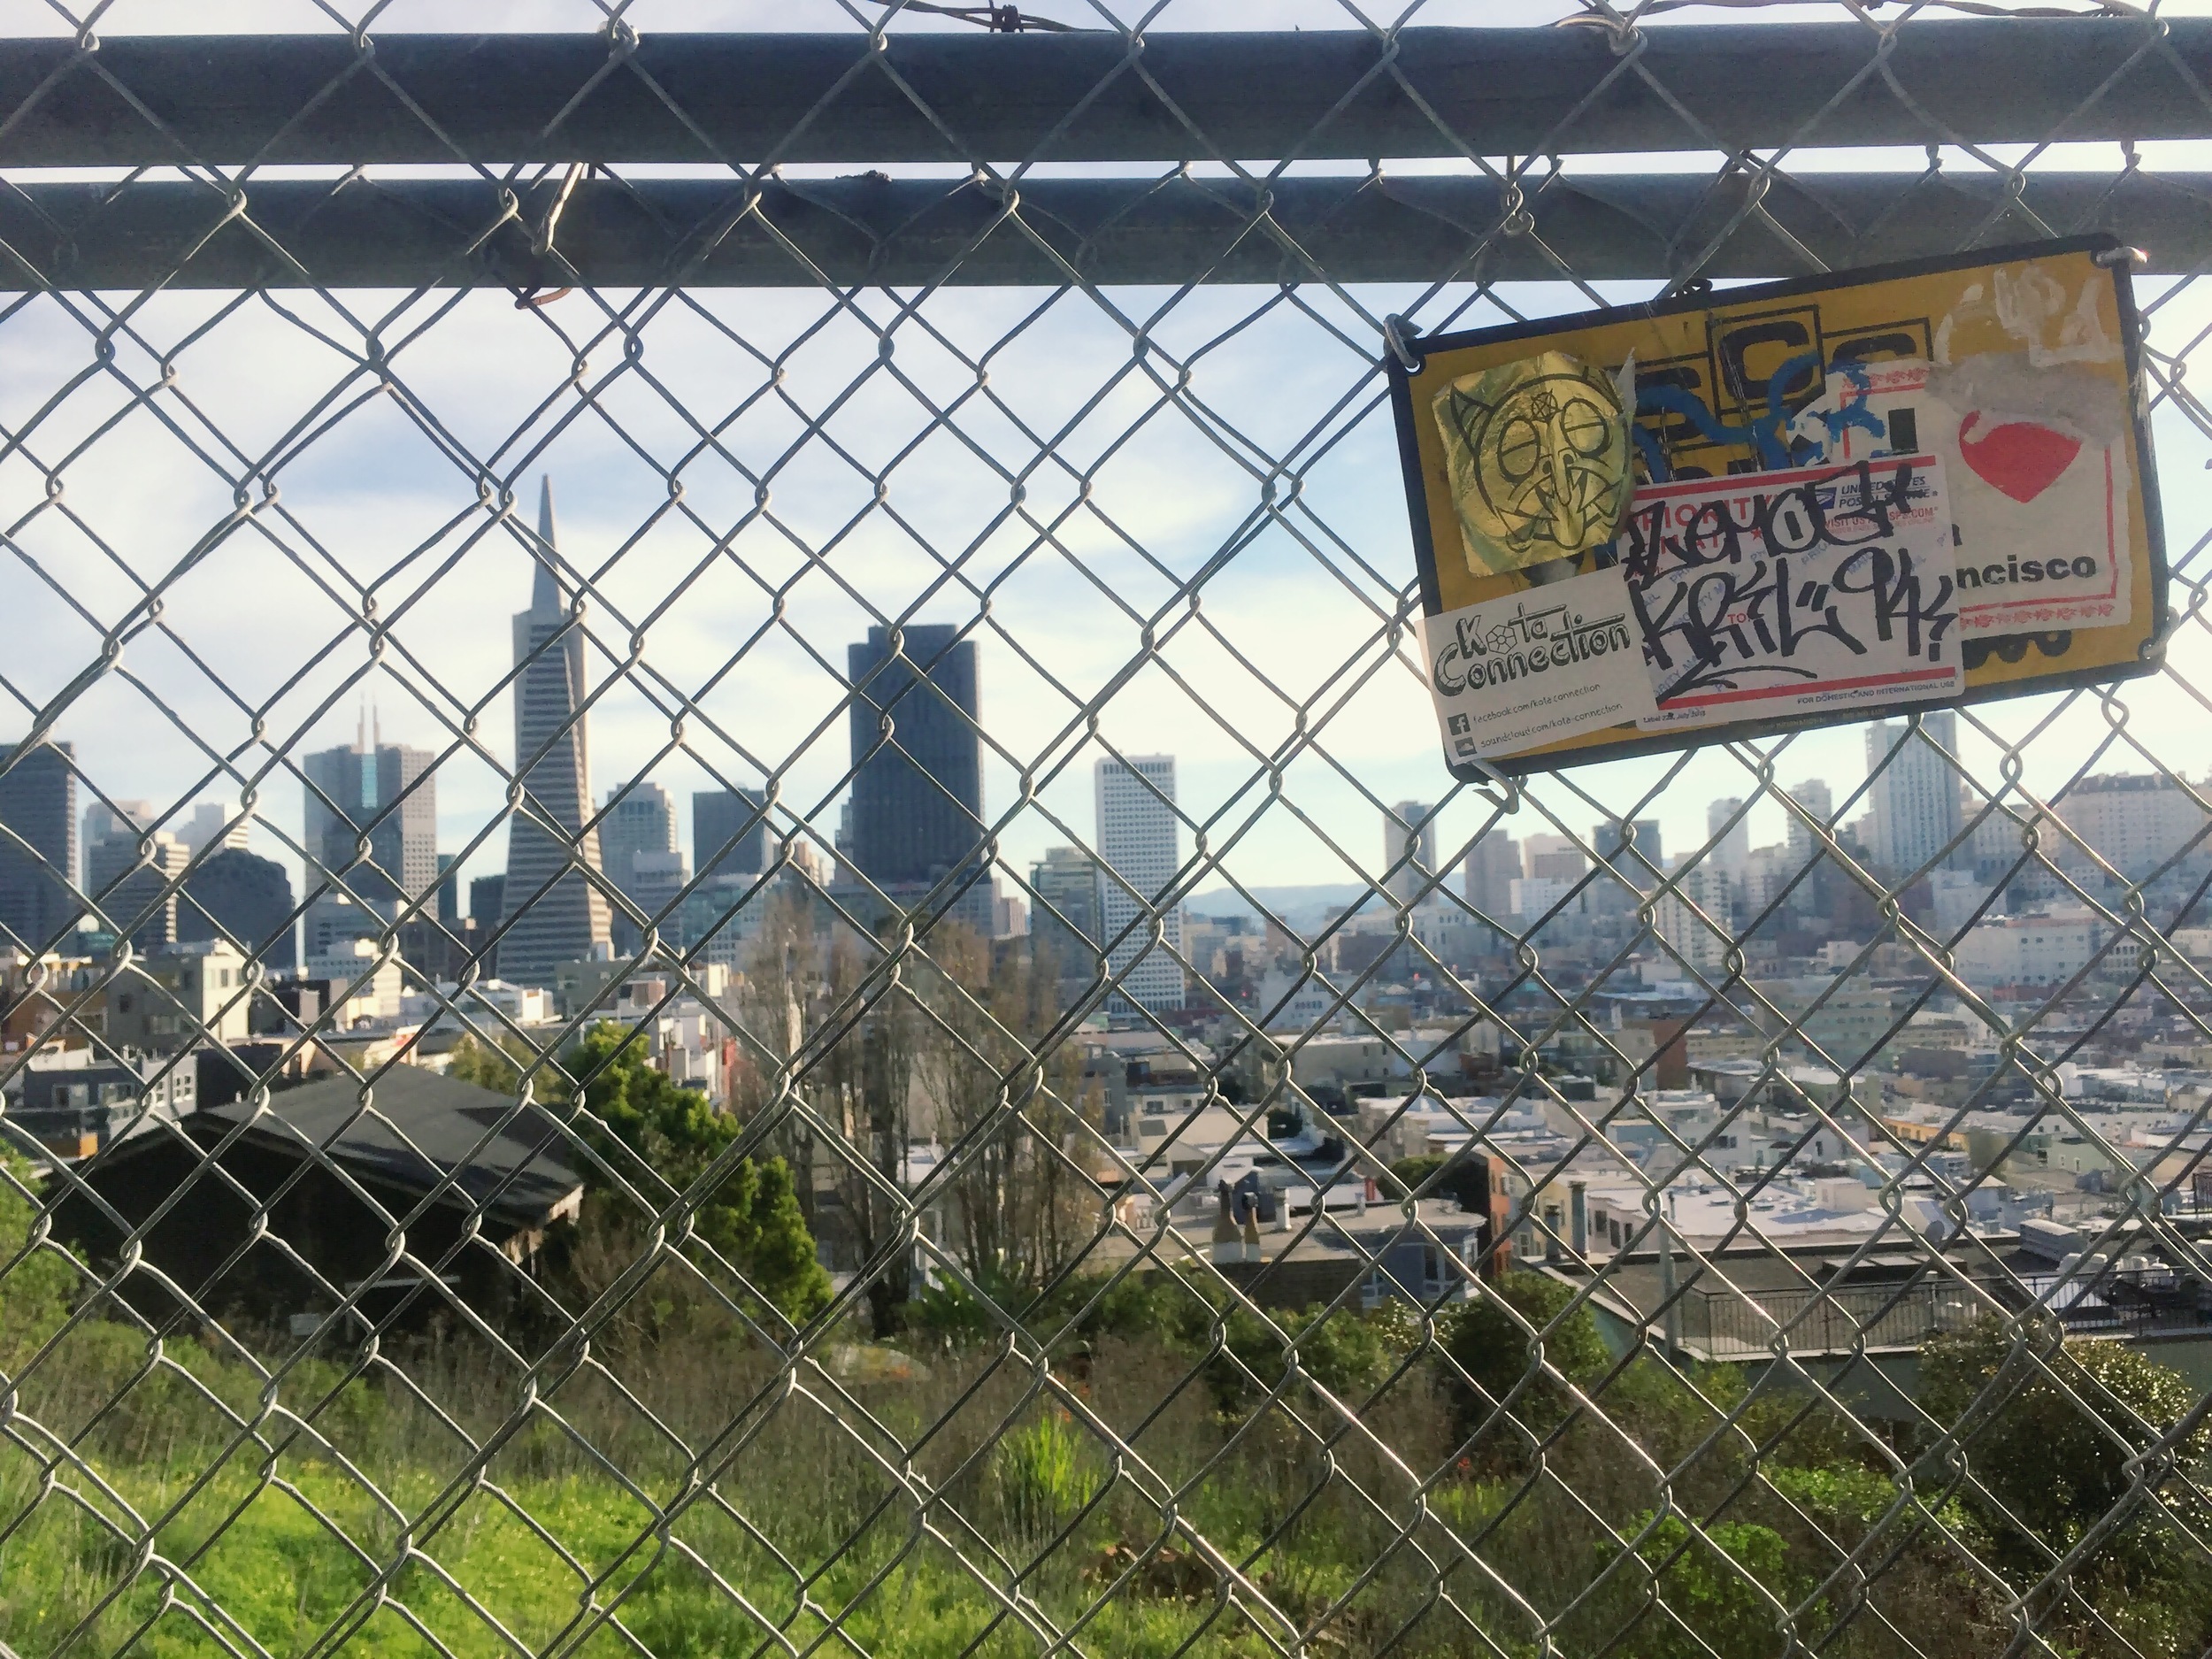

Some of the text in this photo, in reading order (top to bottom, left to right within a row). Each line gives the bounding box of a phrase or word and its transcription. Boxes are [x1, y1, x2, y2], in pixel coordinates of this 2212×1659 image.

[1956, 555, 2096, 589] ncisco
[1434, 611, 1631, 696] Connection
[1816, 691, 1855, 703] DOMESTIC
[1876, 684, 1939, 695] INTERNATIONAL
